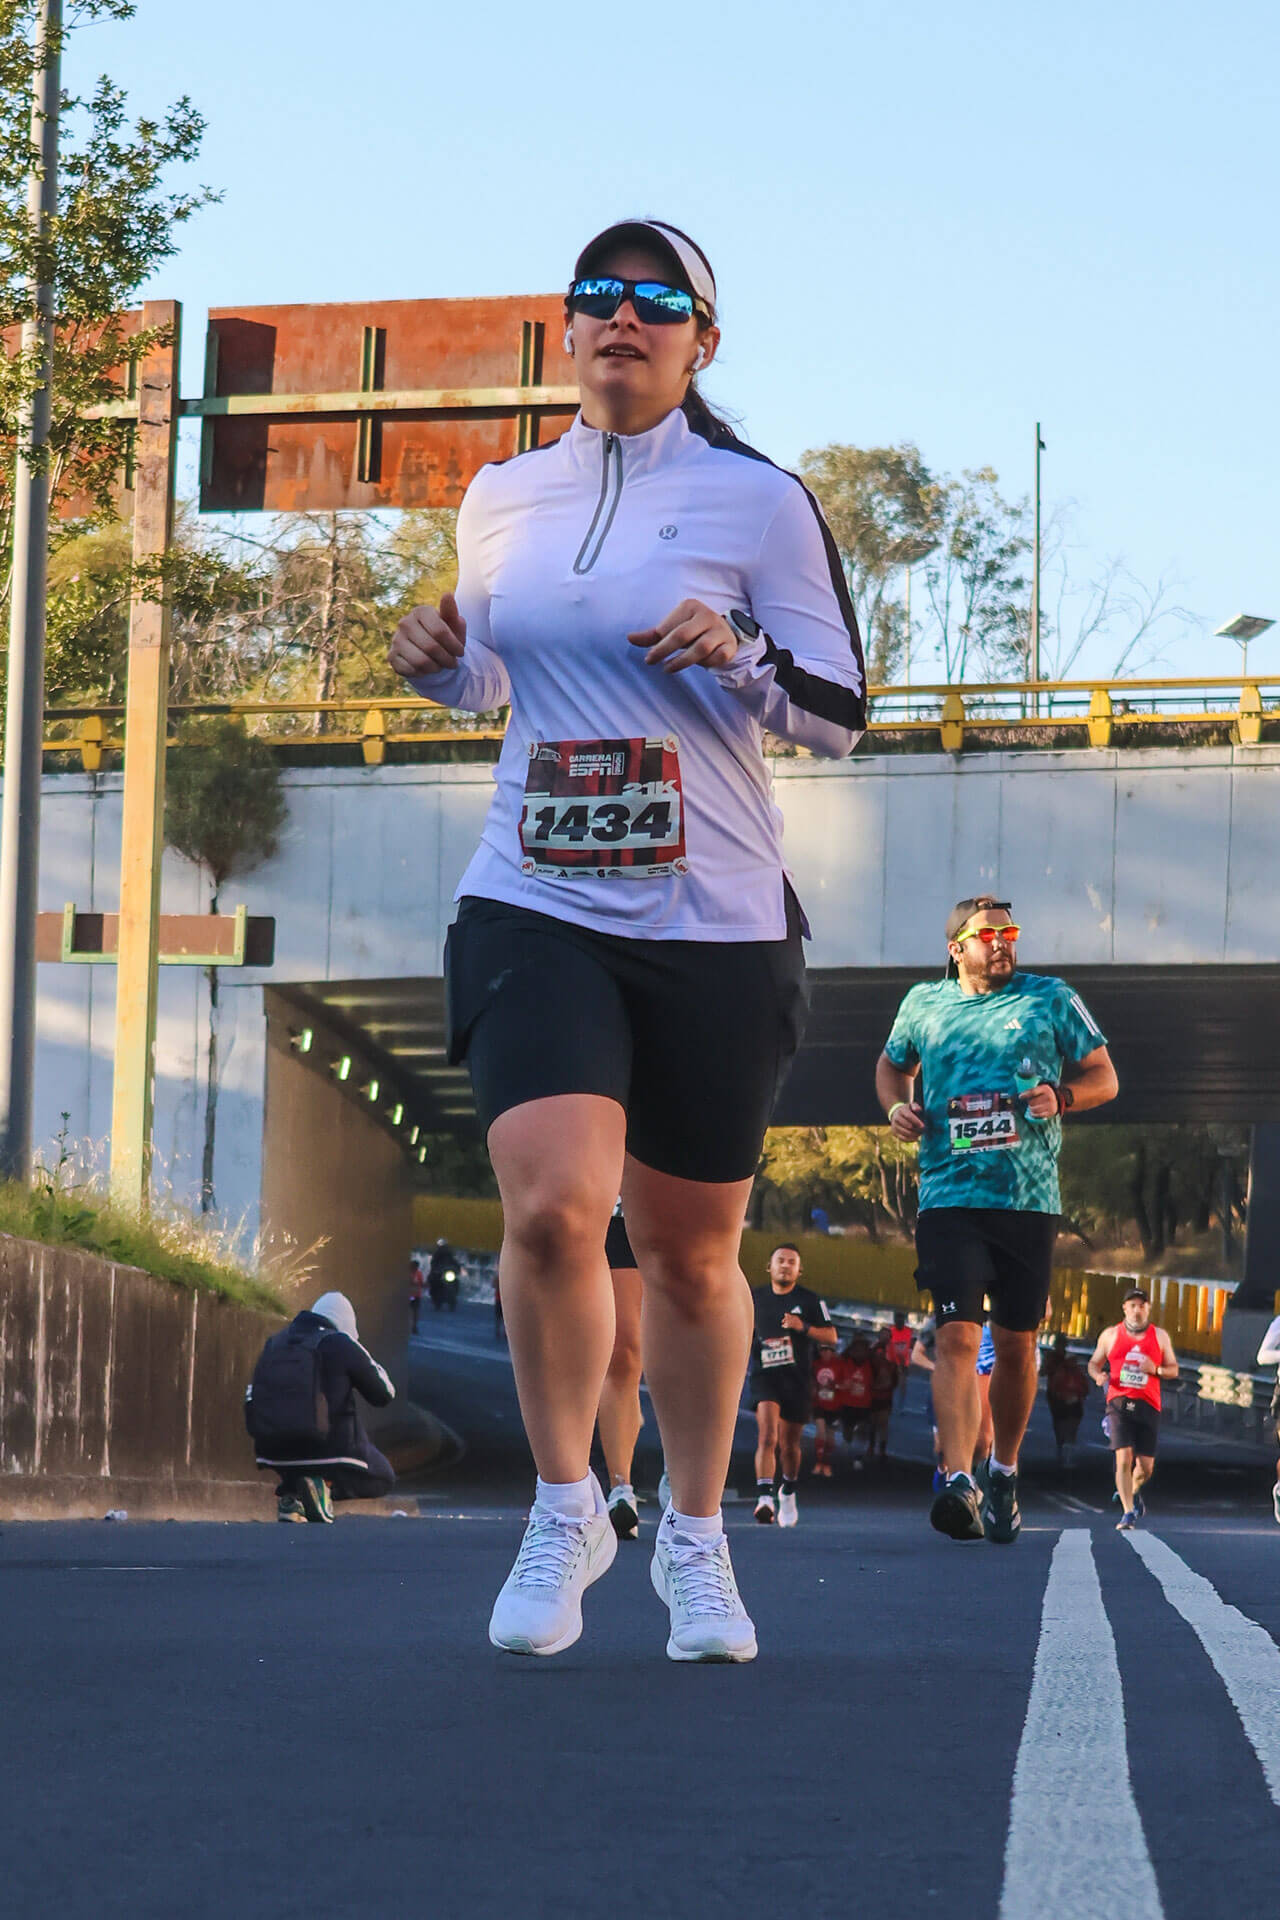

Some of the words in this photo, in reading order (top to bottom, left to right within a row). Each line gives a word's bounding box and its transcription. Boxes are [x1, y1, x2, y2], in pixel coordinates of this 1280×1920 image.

[568, 762, 612, 776] ESPN
[622, 779, 678, 797] 21K
[534, 802, 673, 842] 1434
[954, 1119, 1012, 1139] 1544
